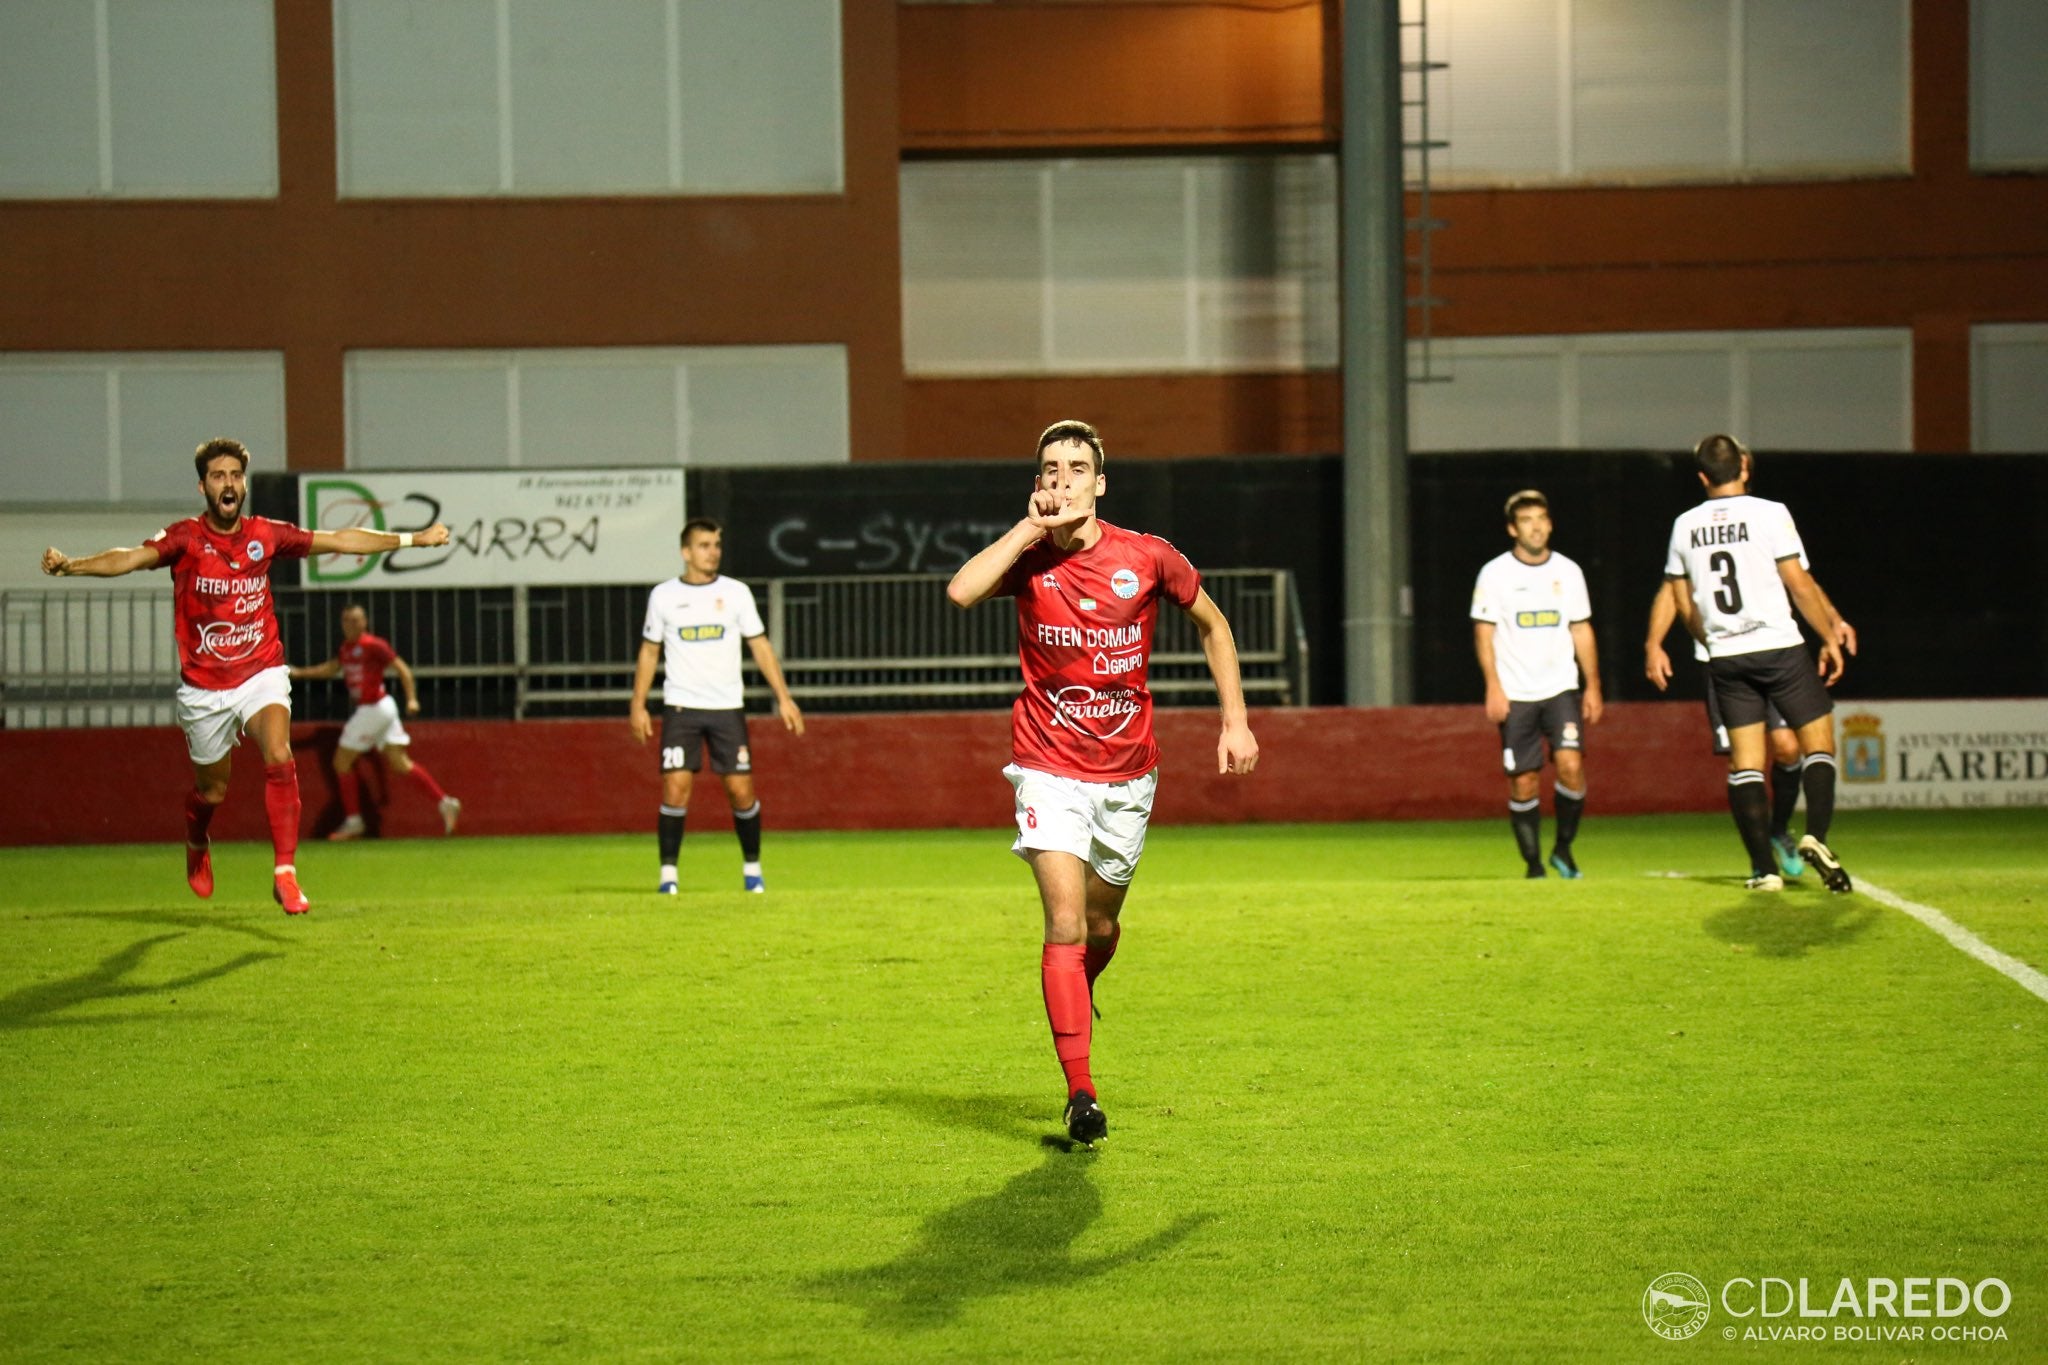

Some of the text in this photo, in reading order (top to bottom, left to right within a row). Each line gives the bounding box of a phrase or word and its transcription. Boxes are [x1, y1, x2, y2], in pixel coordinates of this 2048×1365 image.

[768, 515, 1012, 571] C-SYST
[196, 576, 228, 595] FETEN
[1710, 551, 1744, 615] 3
[1038, 622, 1142, 648] FETEN DOMUM
[1110, 653, 1142, 674] GRUPO
[662, 746, 685, 769] 20
